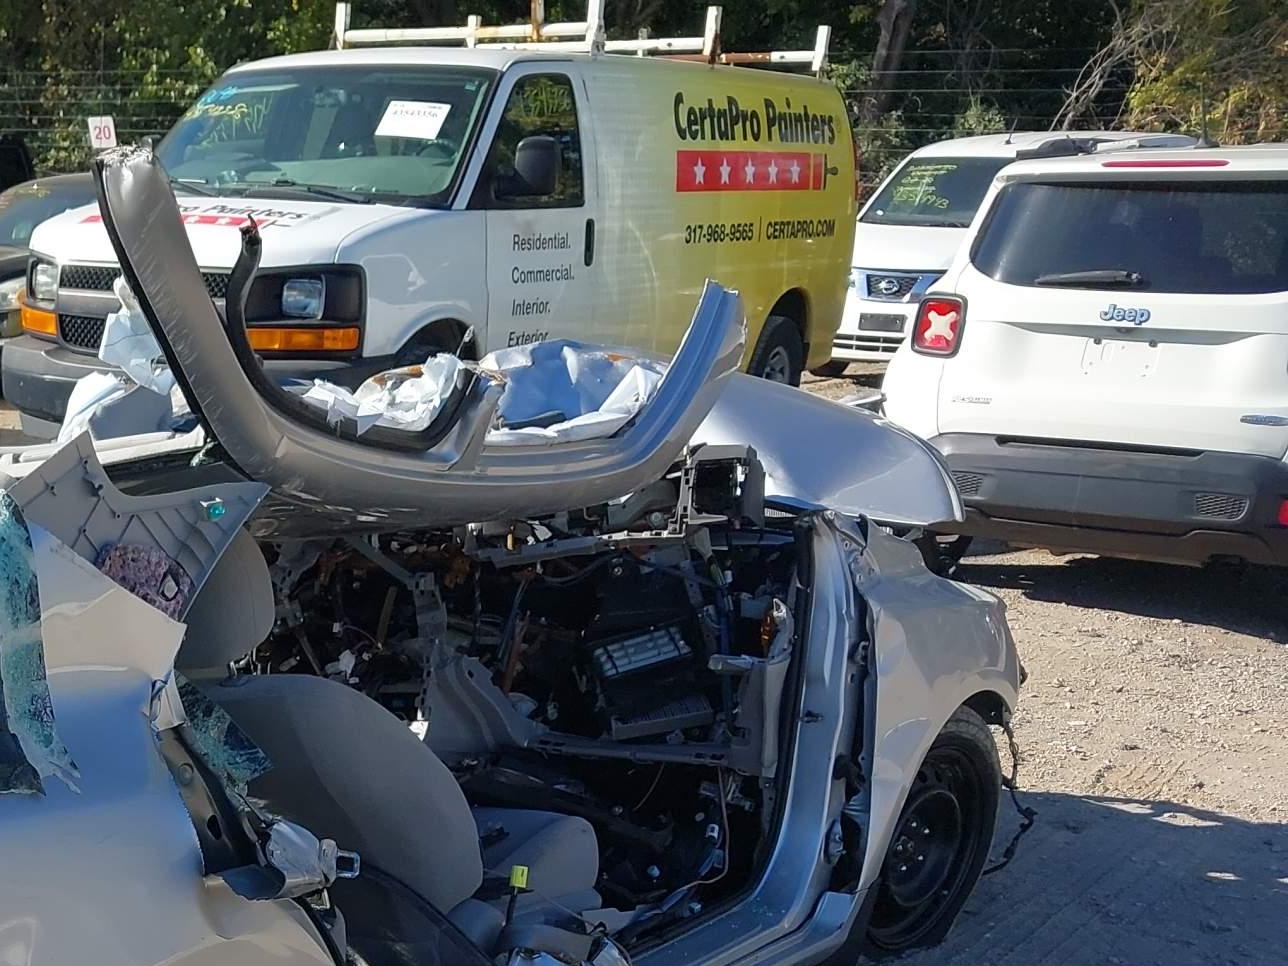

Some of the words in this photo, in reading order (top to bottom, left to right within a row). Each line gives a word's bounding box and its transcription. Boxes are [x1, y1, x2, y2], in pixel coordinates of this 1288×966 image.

[674, 91, 761, 142] CertaPro
[763, 97, 836, 145] Painters
[94, 125, 112, 140] 20
[201, 204, 309, 220] Painters
[512, 231, 571, 252] Residential.
[684, 222, 754, 244] 317-968-9565
[766, 219, 836, 240] CERTAPRO.COM
[511, 263, 575, 284] Commercial.
[511, 296, 551, 316] Interior.
[1099, 303, 1151, 326] Jeep
